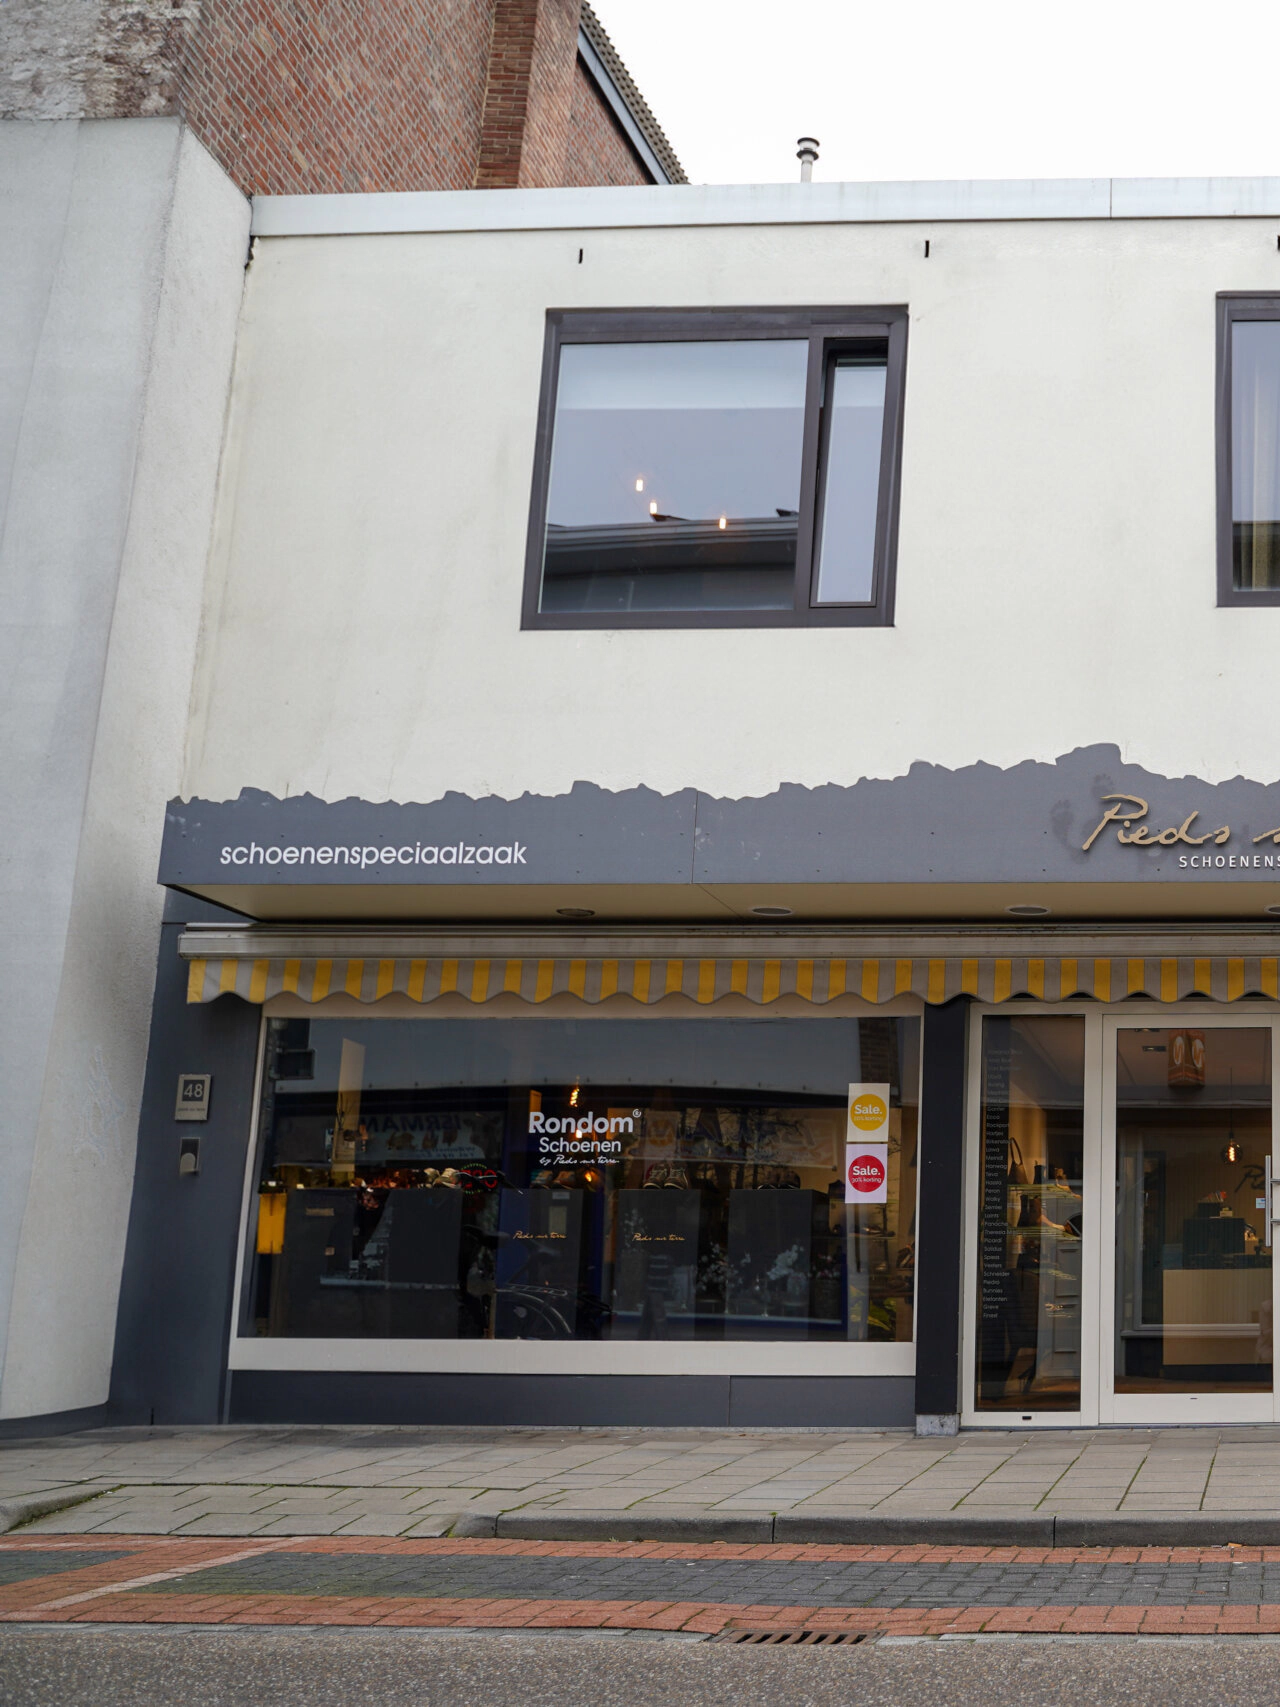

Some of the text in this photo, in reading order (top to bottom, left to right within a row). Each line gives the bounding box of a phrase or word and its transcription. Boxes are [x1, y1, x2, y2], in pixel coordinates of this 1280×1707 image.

[1082, 794, 1231, 851] Pieds
[219, 841, 527, 869] schoenenspeciaalzaak
[184, 1083, 204, 1098] 48
[538, 1137, 622, 1153] Schoenen
